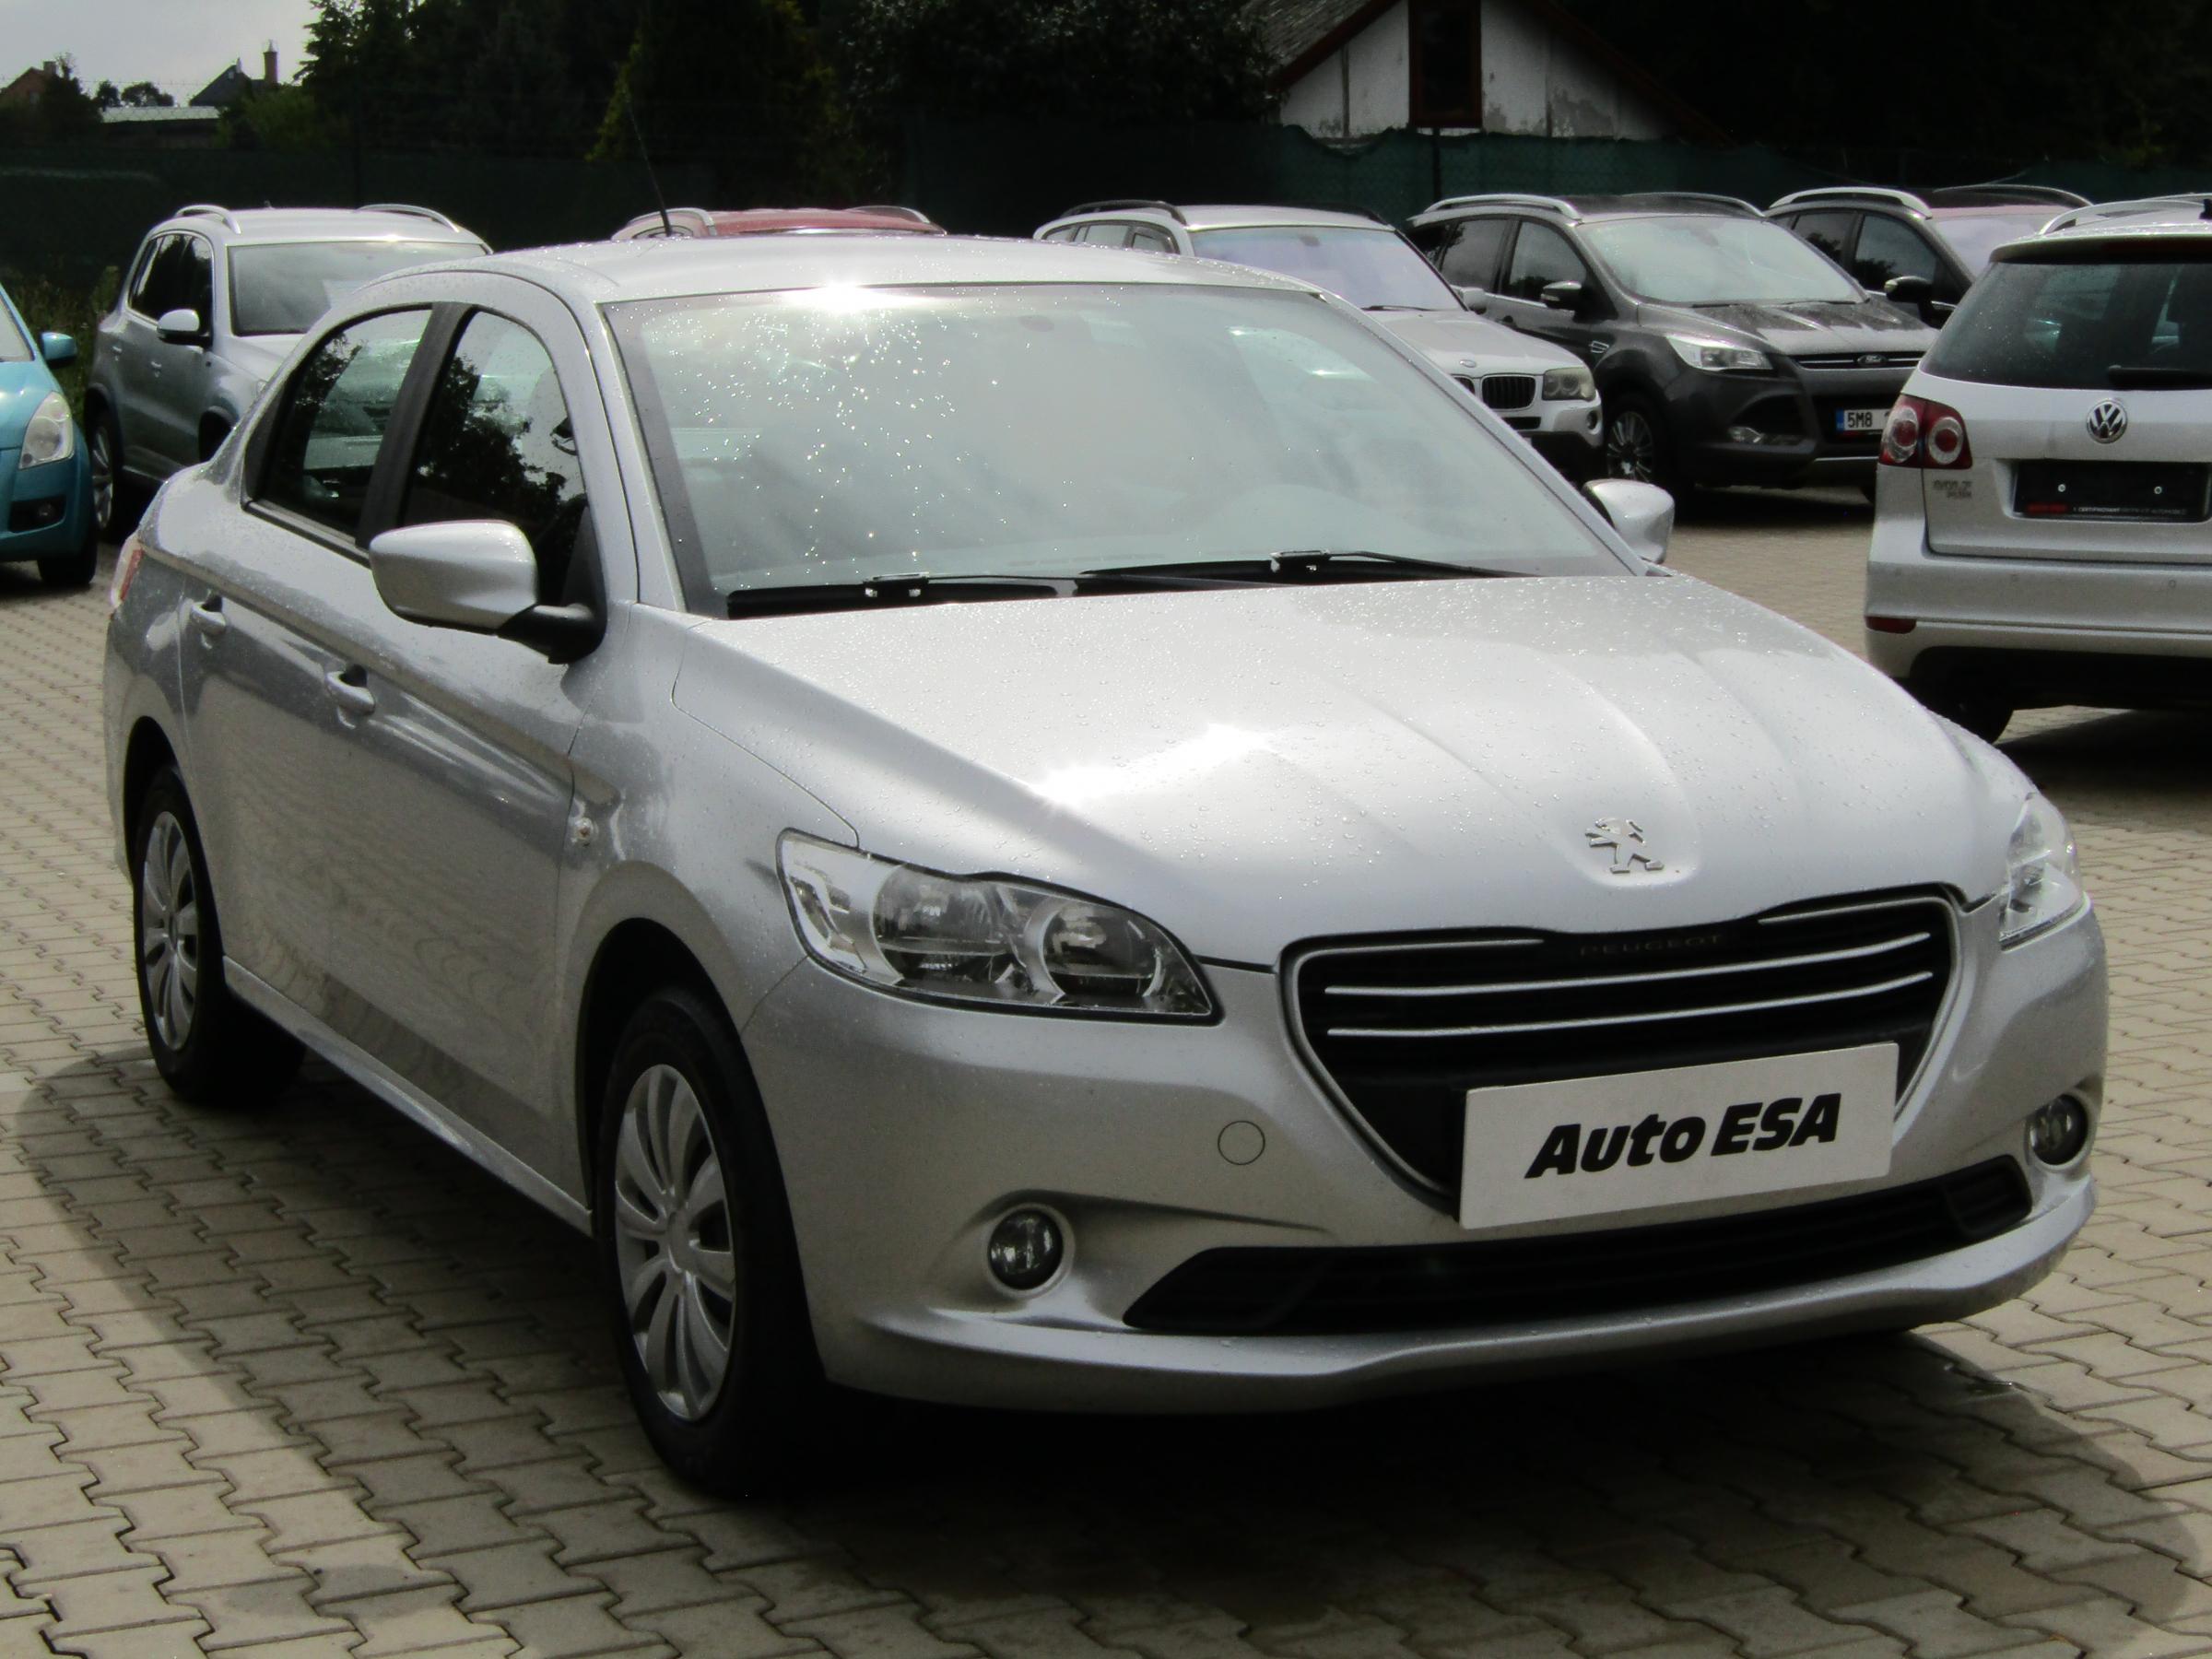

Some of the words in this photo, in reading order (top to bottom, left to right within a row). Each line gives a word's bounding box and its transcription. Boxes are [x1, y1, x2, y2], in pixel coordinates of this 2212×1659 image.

[1847, 412, 1873, 428] 5M8
[1579, 933, 1724, 957] PEUGEOT
[1524, 1113, 1706, 1180] Auto
[1711, 1092, 1842, 1157] ESA
